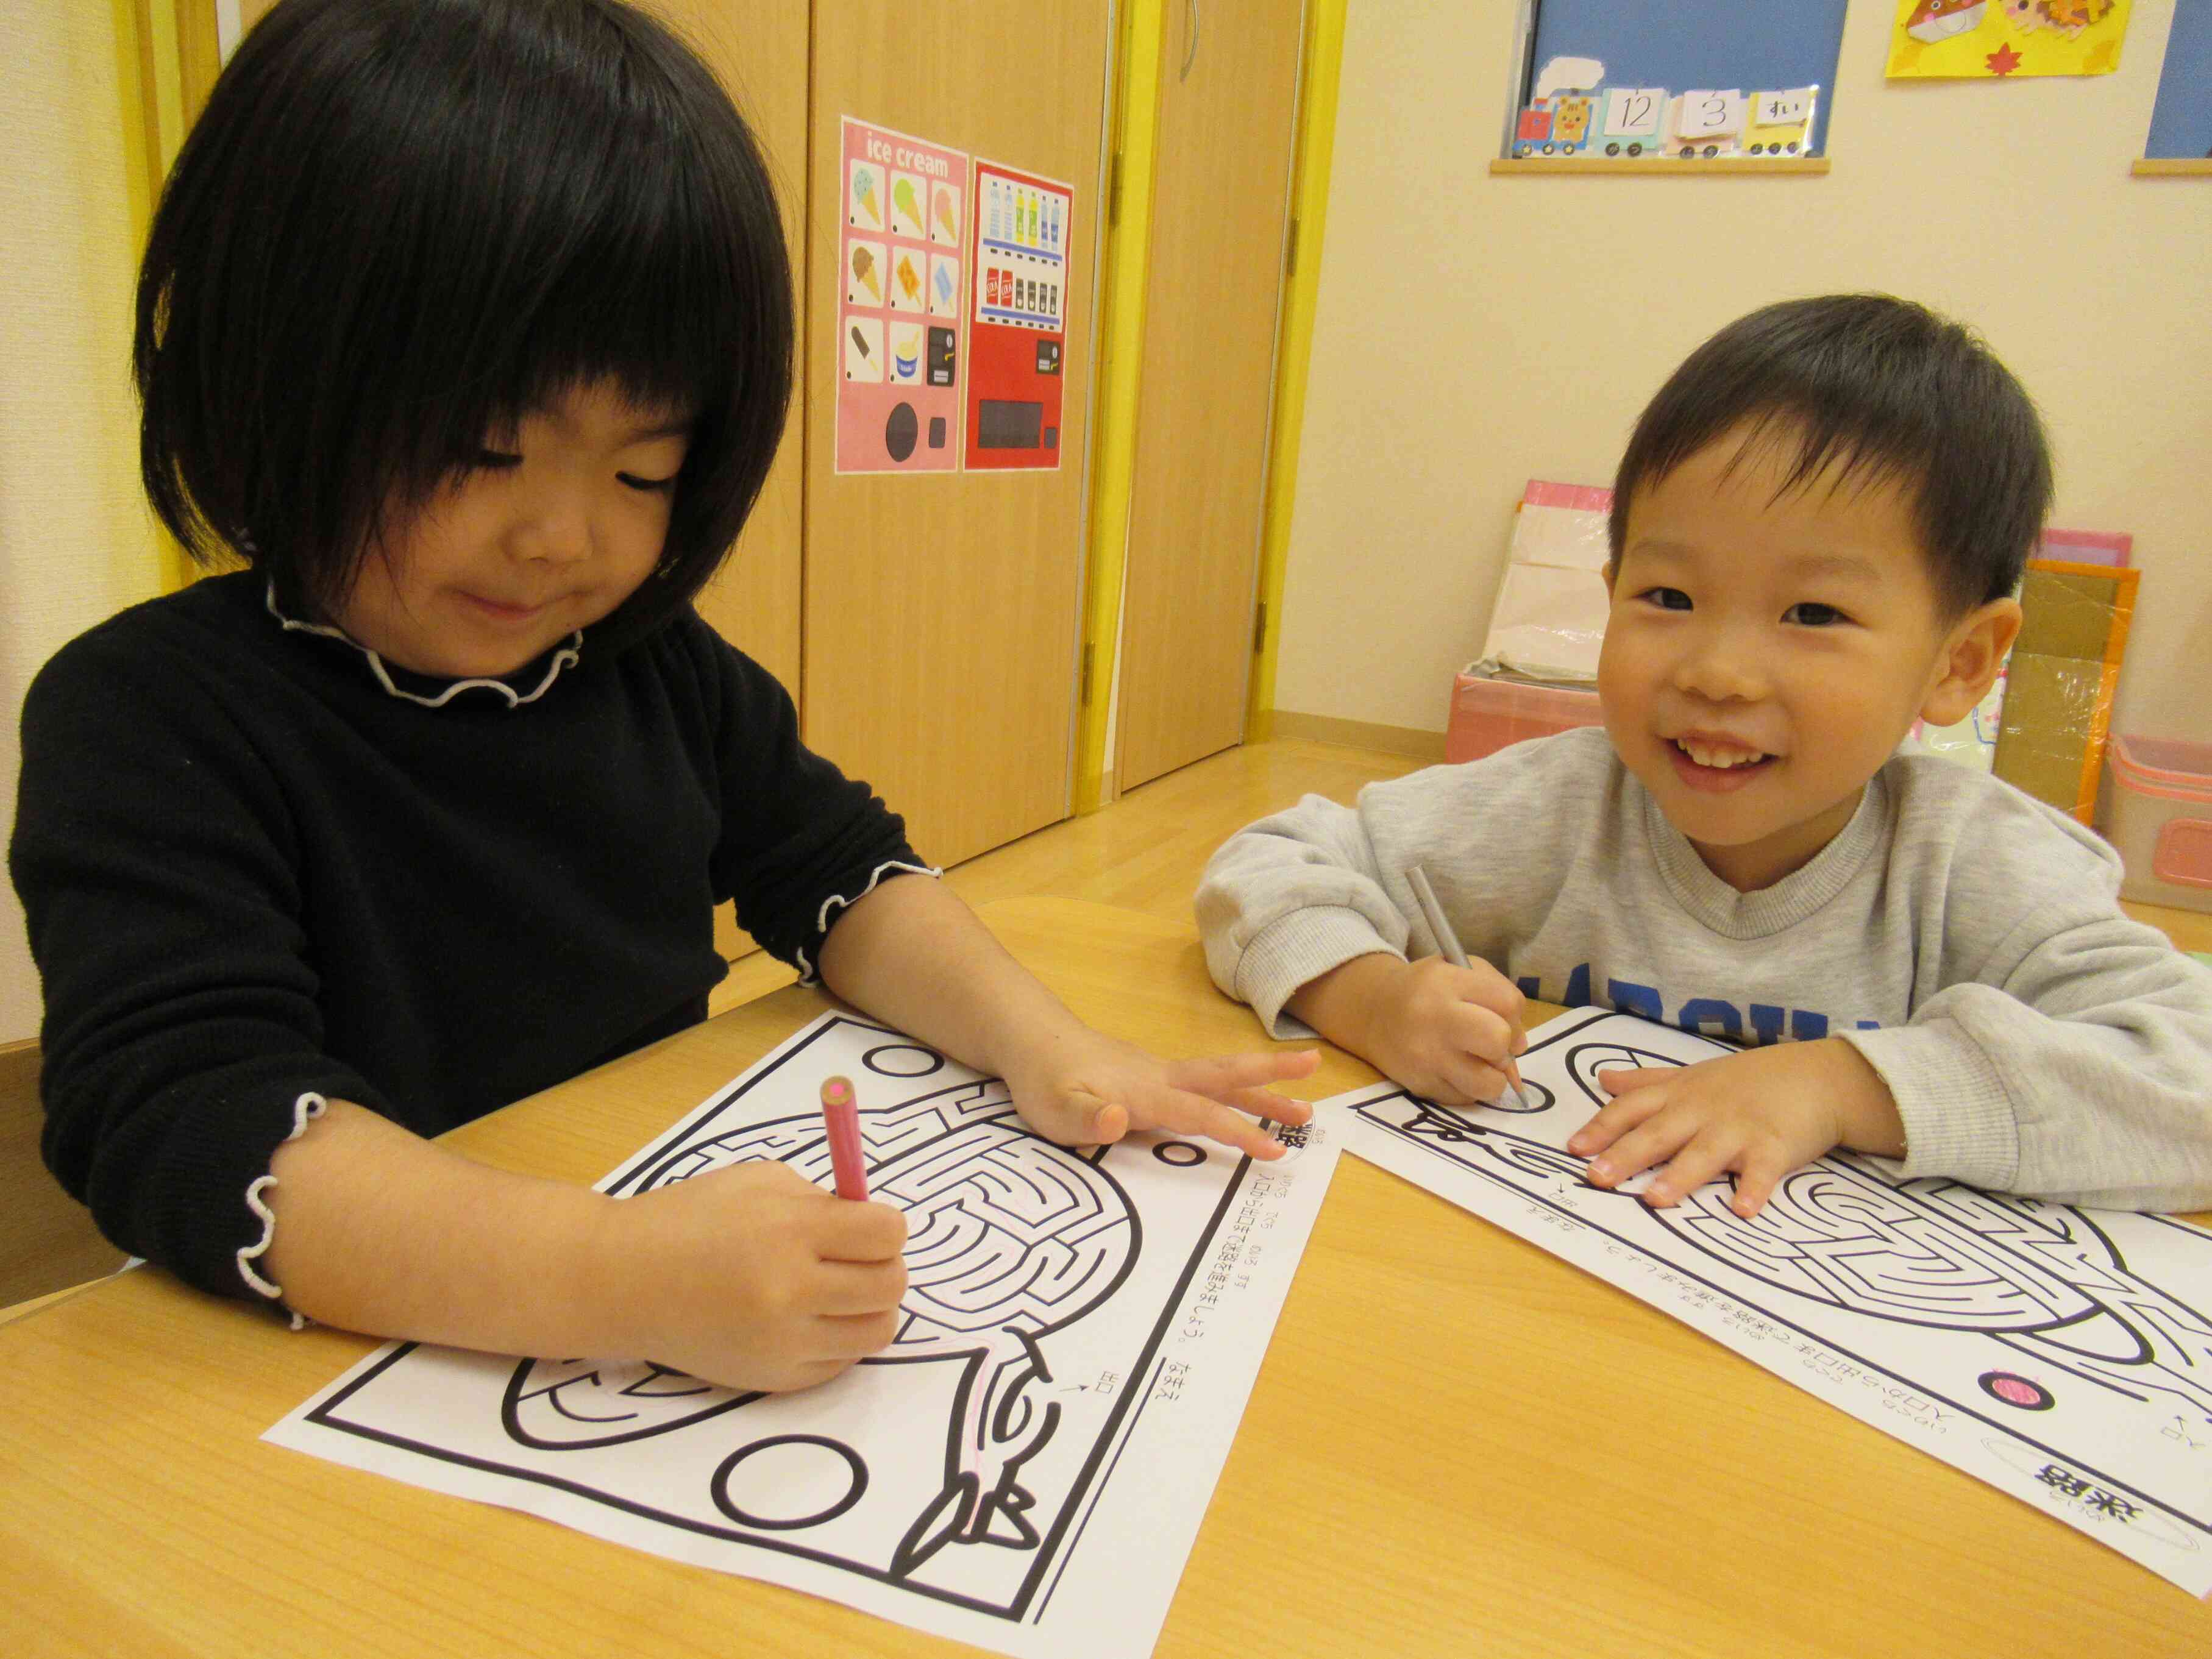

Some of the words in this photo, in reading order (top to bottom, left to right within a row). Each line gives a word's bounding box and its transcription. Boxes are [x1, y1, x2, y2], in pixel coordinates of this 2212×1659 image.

[1623, 96, 1651, 127] 12
[1702, 98, 1726, 126] 3
[868, 130, 892, 163] ice
[896, 147, 948, 177] cream
[1095, 1371, 1119, 1394] 出口
[1155, 1362, 1192, 1401] なまえ
[2034, 1464, 2144, 1523] 迷路
